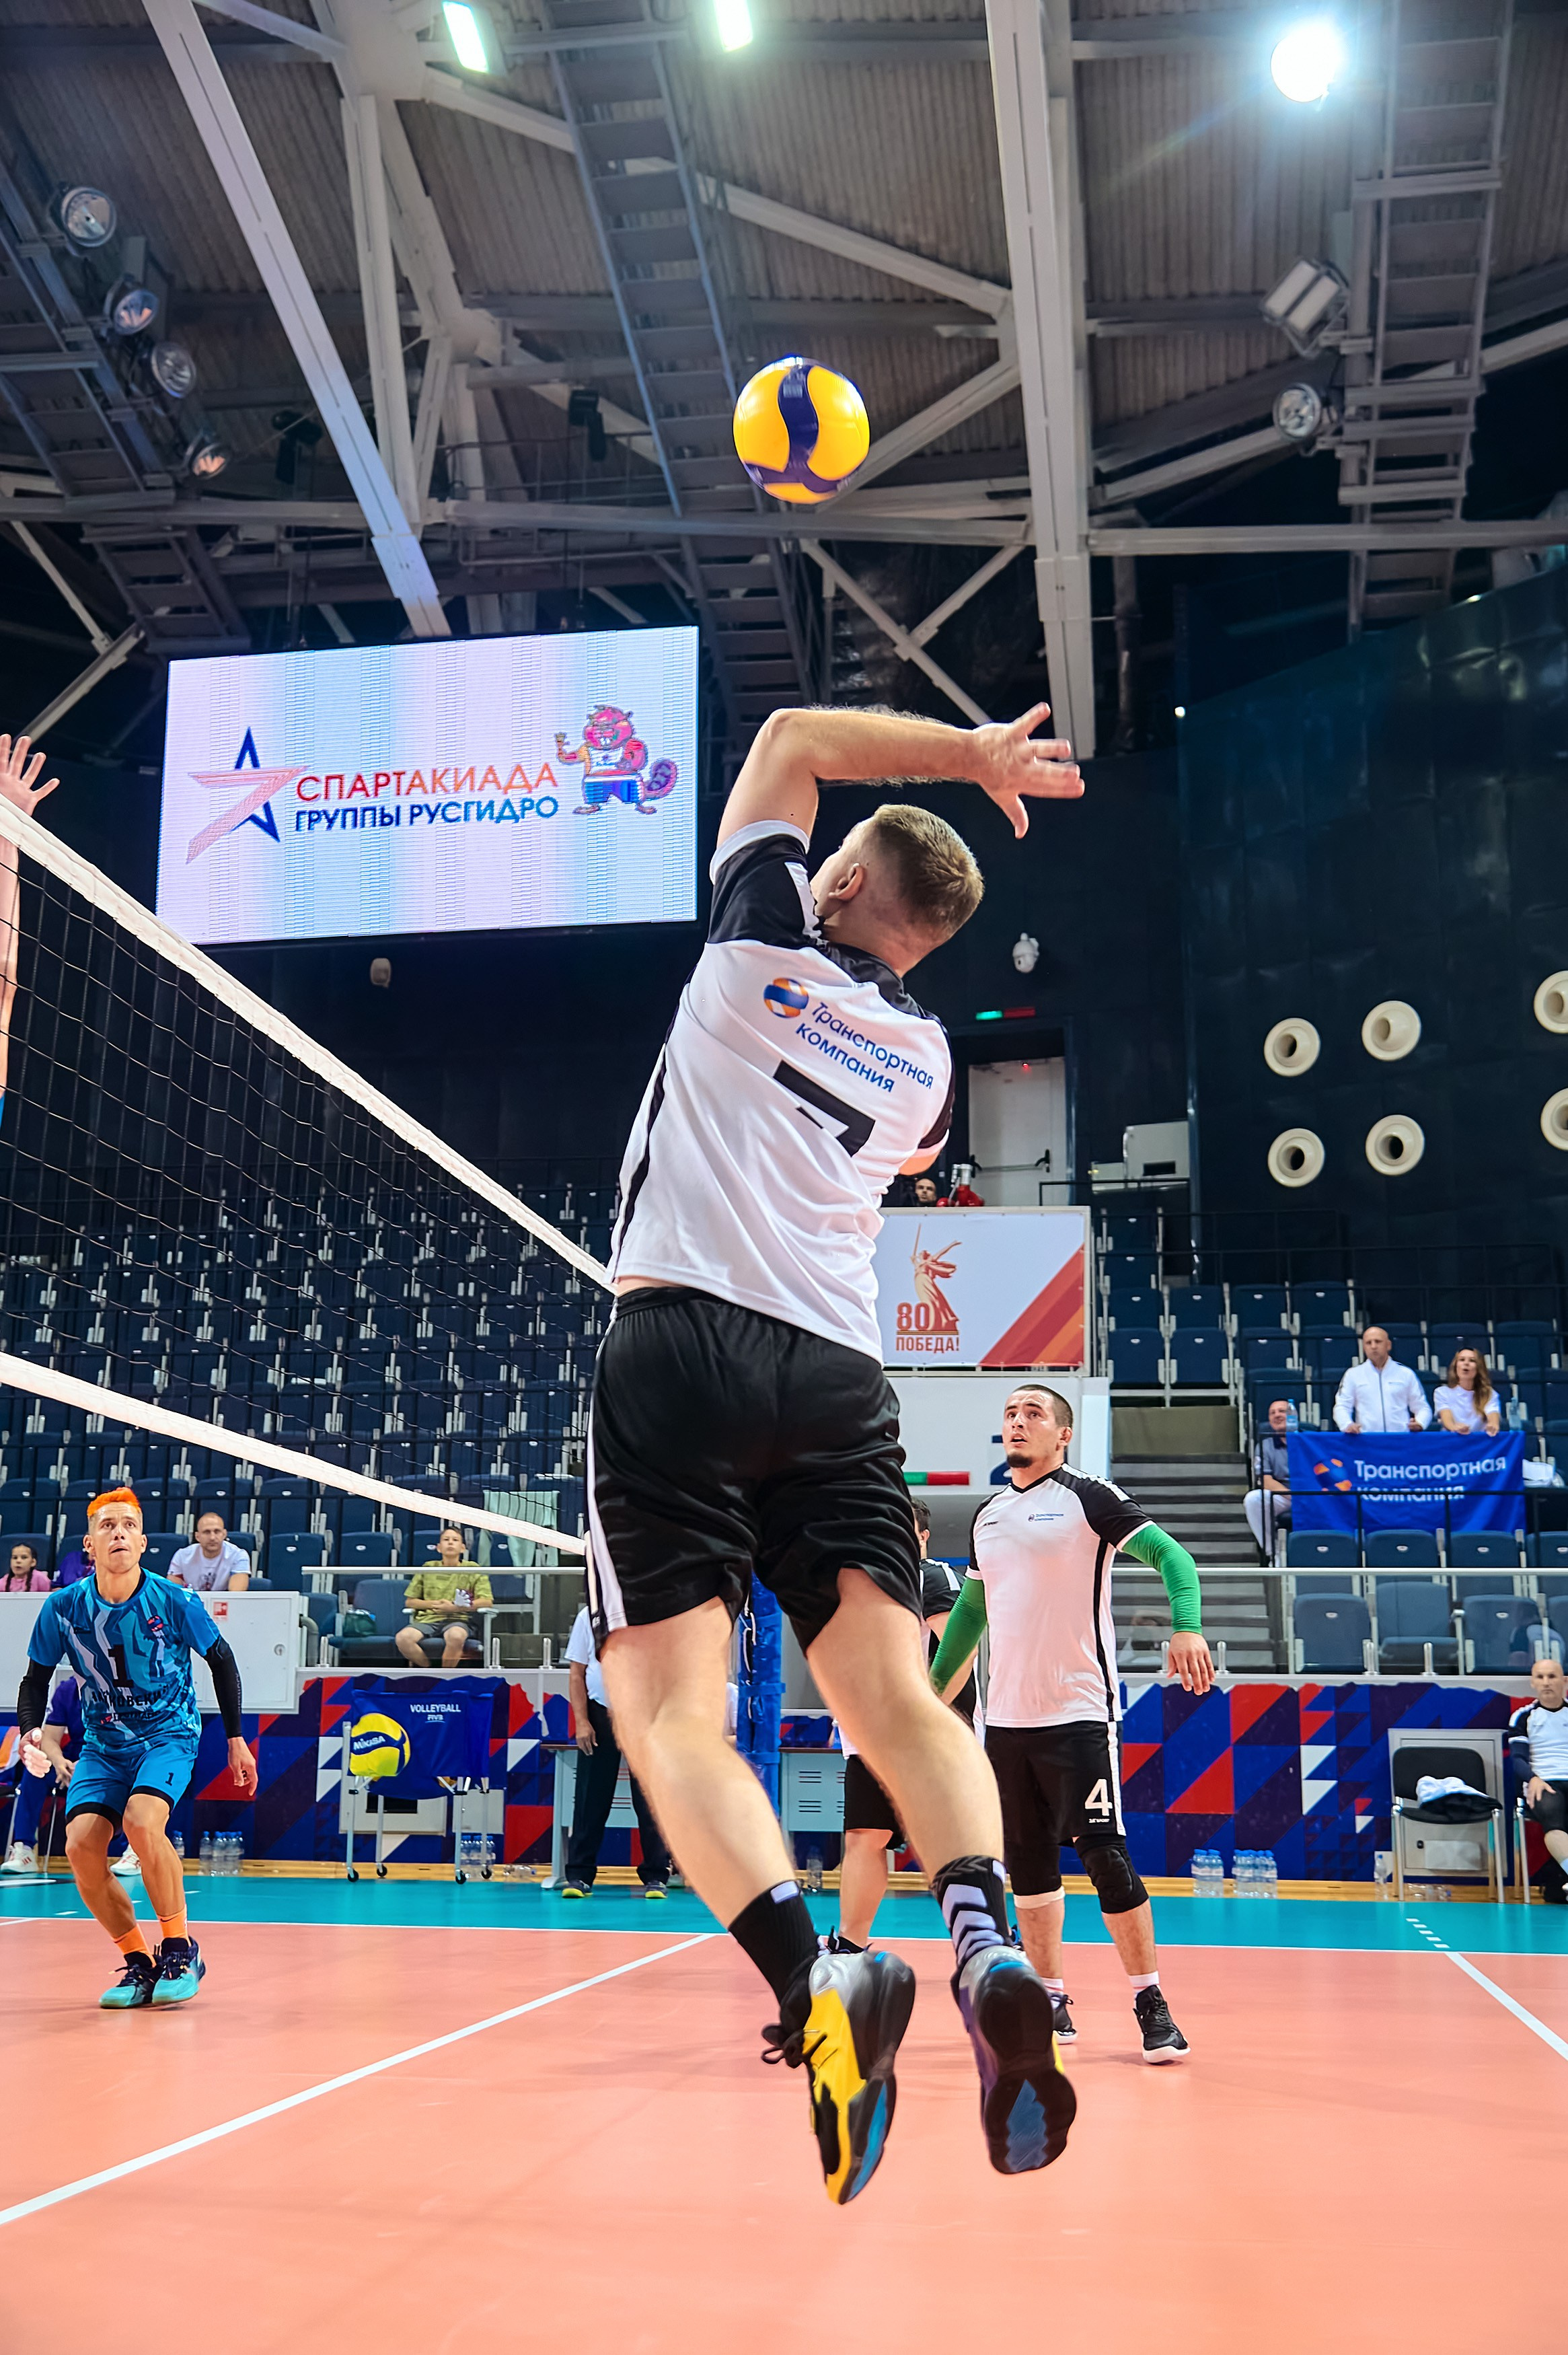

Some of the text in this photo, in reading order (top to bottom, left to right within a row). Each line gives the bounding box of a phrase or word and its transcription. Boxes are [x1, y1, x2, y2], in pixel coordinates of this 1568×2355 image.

[296, 762, 559, 801] СПАРТАКИАДА
[295, 795, 559, 832] ГРУППЫ РУСГИДРО
[796, 1023, 895, 1093] компания
[811, 1002, 934, 1089] Транспортная
[897, 1302, 930, 1331] 80
[895, 1336, 959, 1353] ПОБЕДА!
[1353, 1456, 1506, 1481] Транспортная
[108, 1644, 134, 1688] 1
[410, 1704, 461, 1713] VOLLEYBALL
[165, 1772, 174, 1786] 1
[1084, 1778, 1113, 1816] 4
